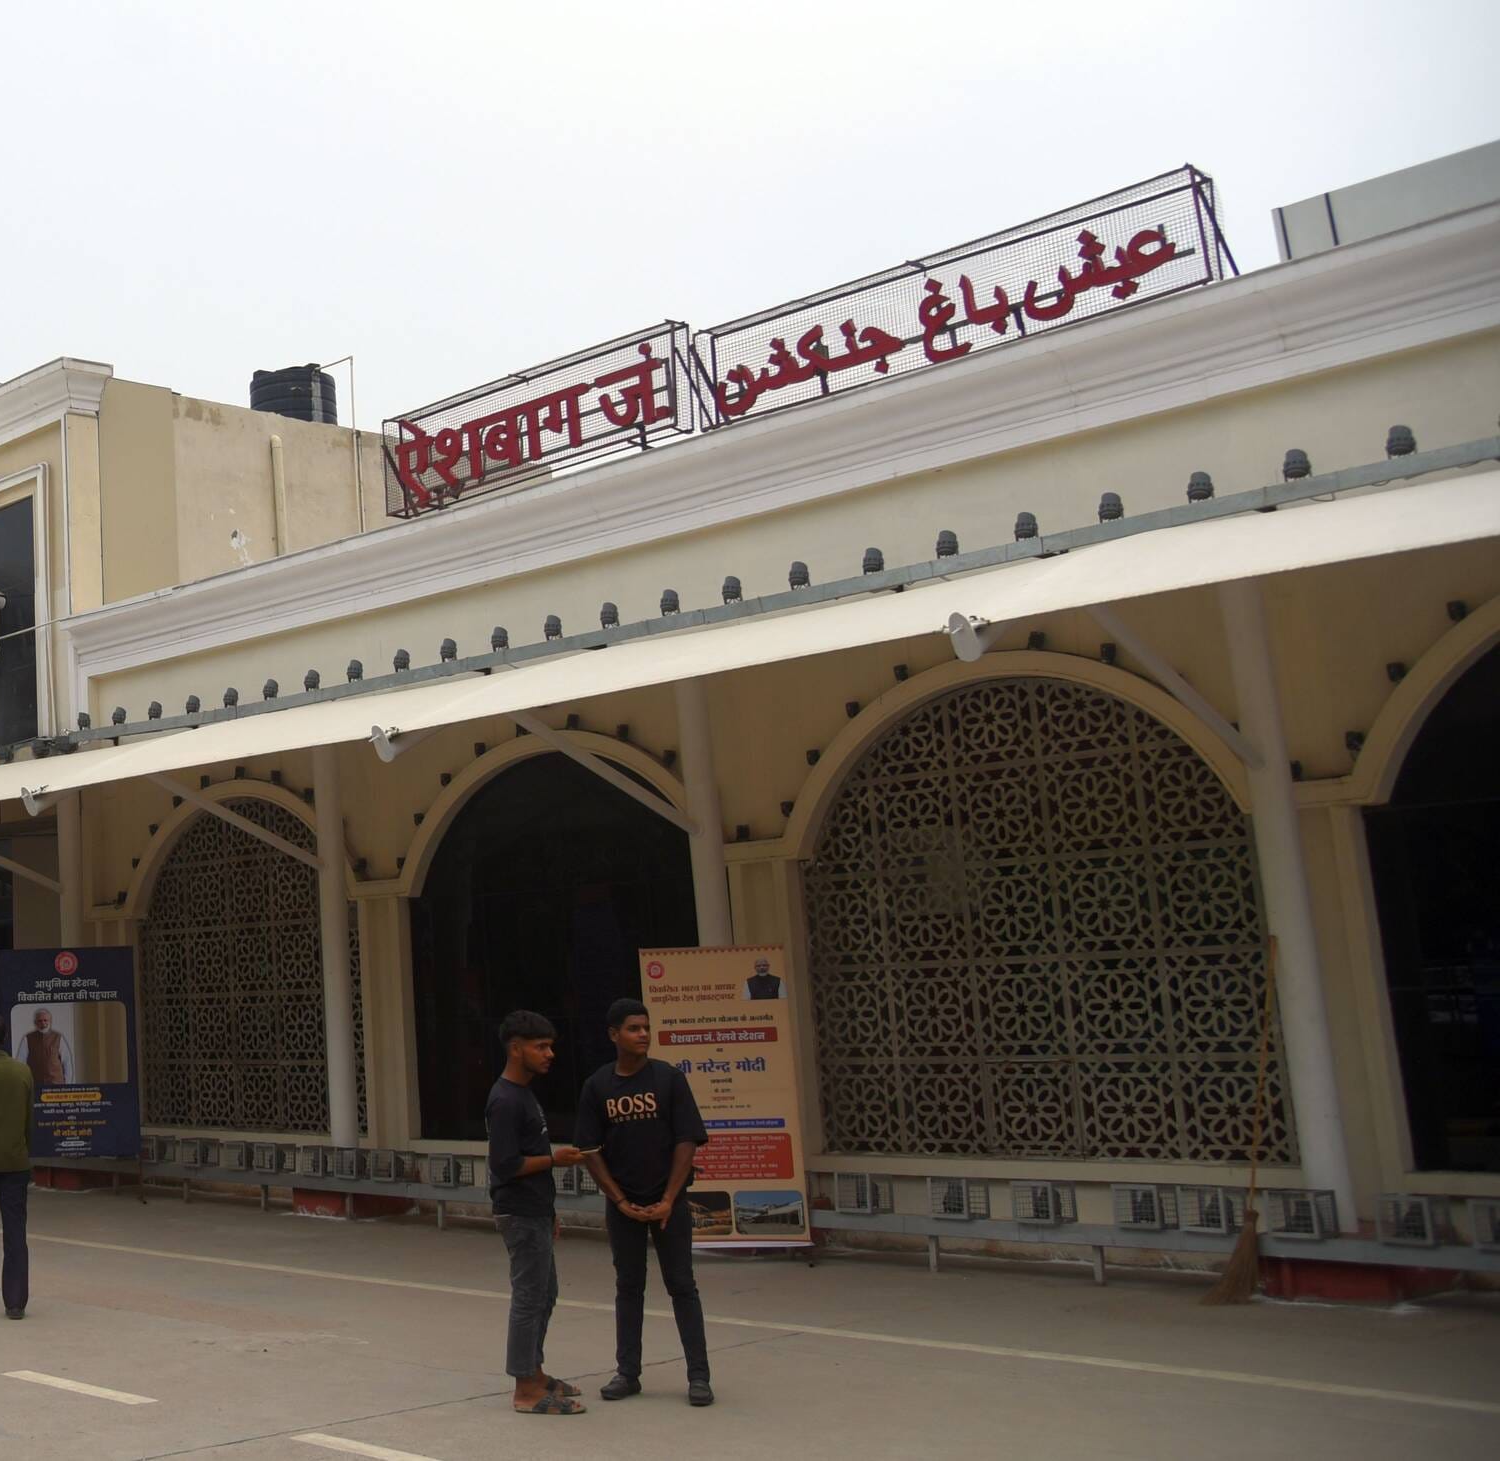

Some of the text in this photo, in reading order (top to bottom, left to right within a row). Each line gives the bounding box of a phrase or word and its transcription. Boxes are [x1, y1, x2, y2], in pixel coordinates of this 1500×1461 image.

[918, 273, 1011, 365] باغ
[395, 383, 592, 510] ऐशबाग
[35, 977, 70, 991] आधुनिक
[18, 989, 118, 1002] विकसित भारत की पहचान
[716, 1031, 736, 1041] रेलवे
[738, 1030, 765, 1040] स्टेशन
[696, 1058, 730, 1073] नरेन्द्र
[736, 1056, 766, 1072] मोदी
[606, 1092, 657, 1118] BOSS
